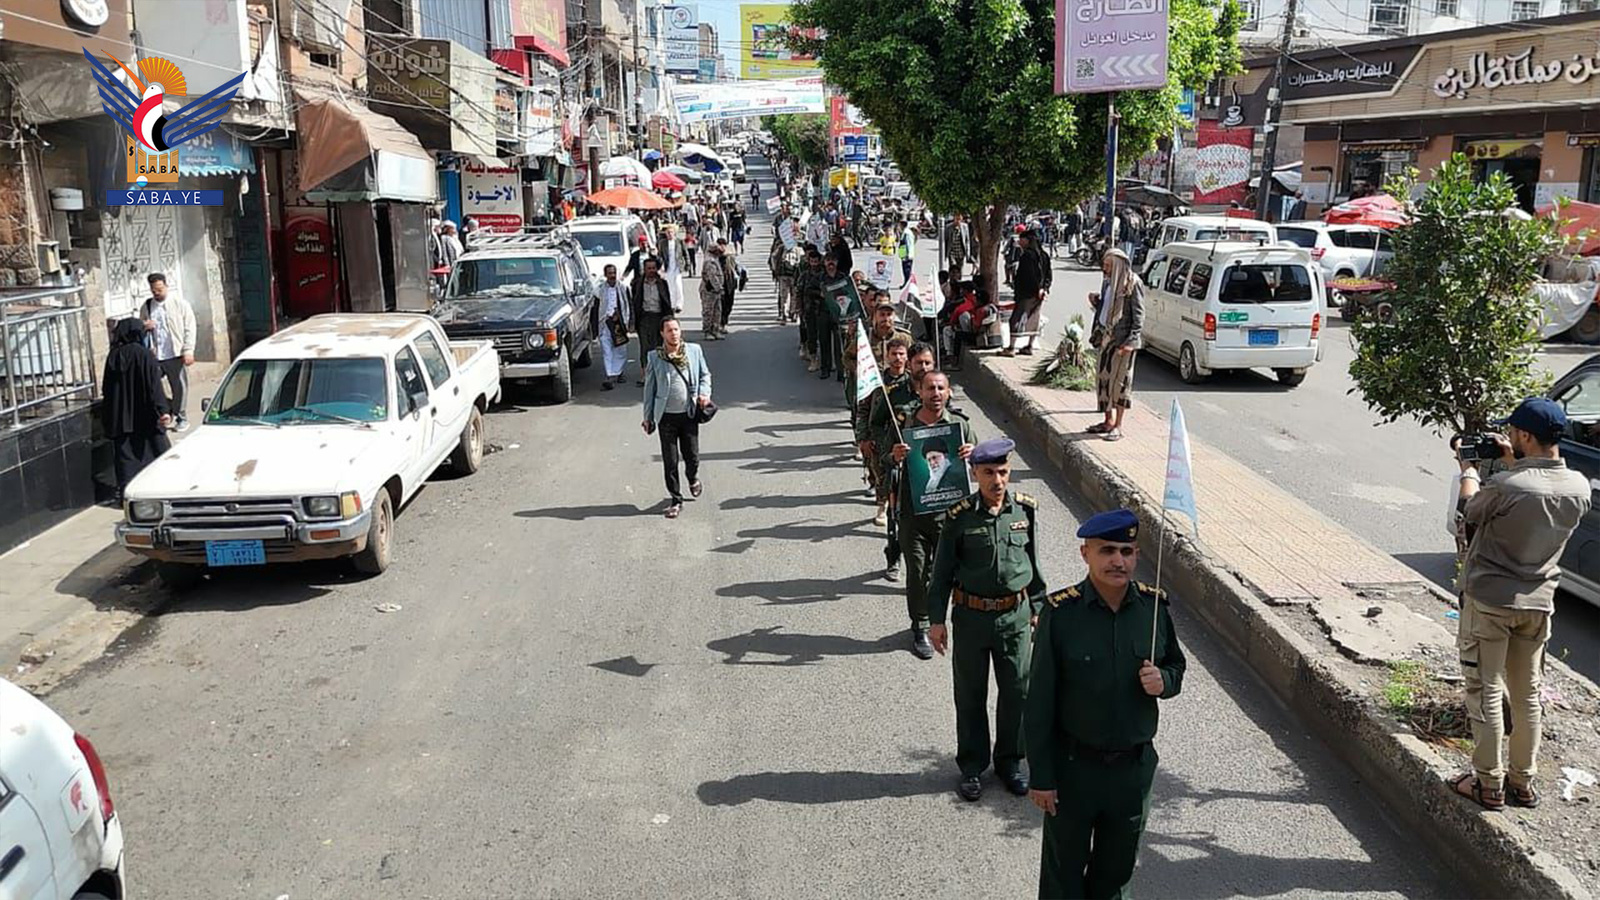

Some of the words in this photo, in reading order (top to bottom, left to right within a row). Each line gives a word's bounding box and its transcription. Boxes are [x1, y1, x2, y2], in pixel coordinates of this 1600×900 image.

[1080, 31, 1117, 47] العوائل
[1121, 31, 1157, 45] مدخل
[370, 44, 447, 78] شواية
[1346, 61, 1393, 80] للبهارات
[1484, 47, 1562, 88] مملكة
[1287, 68, 1346, 87] والمكسرات
[1434, 52, 1487, 99] البن
